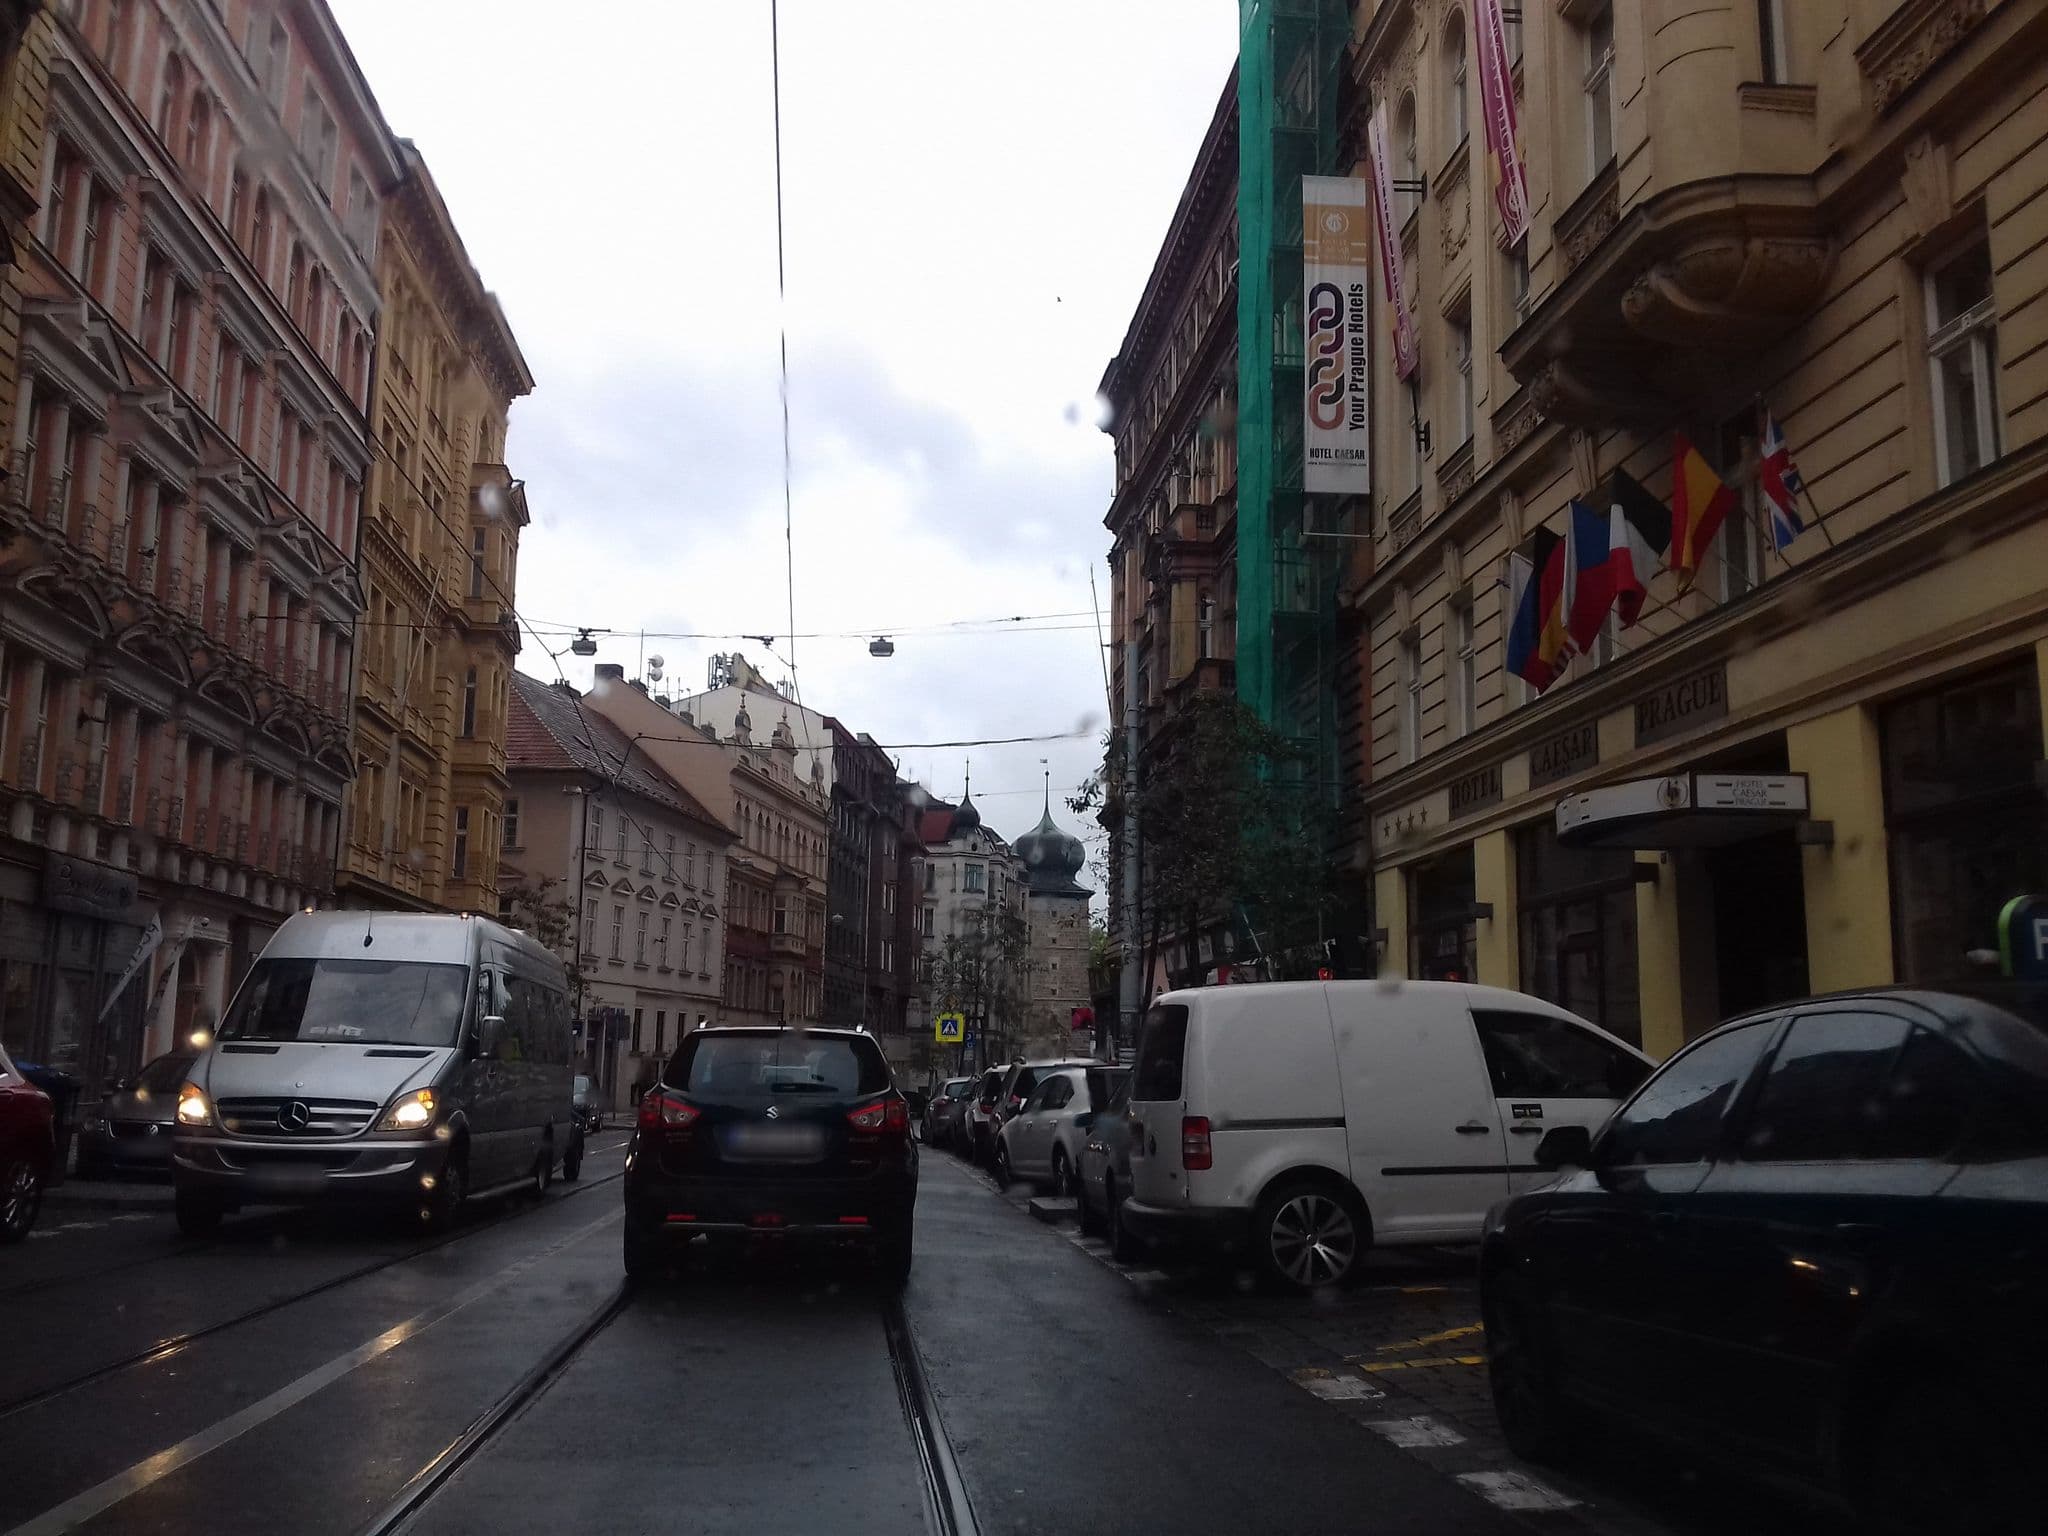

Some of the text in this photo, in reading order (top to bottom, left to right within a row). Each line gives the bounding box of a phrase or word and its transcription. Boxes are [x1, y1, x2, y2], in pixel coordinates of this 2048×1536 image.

[1348, 283, 1366, 431] Your Prague Hotels
[1309, 447, 1366, 460] HOTEL CAESAR
[1451, 671, 1722, 809] HOTEL CAESAR PRAGUE
[1732, 788, 1768, 797] CAESAR
